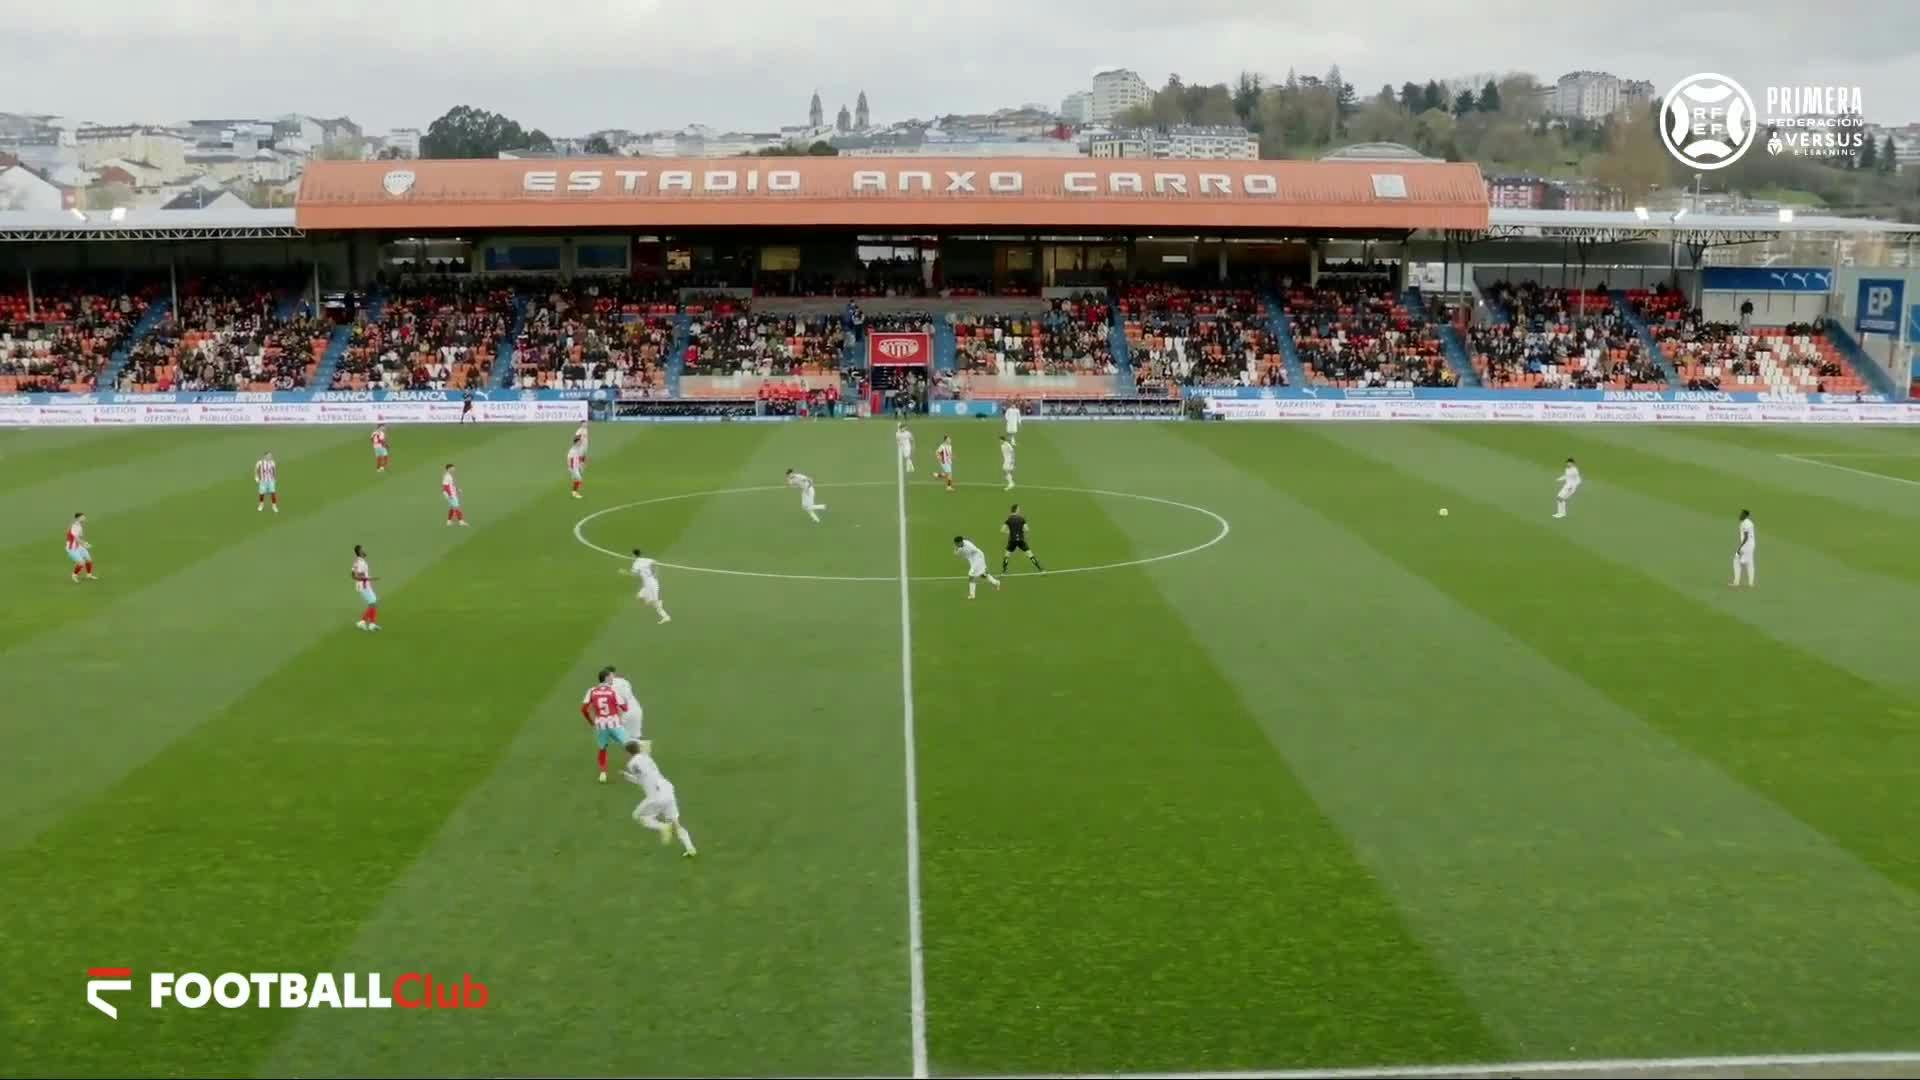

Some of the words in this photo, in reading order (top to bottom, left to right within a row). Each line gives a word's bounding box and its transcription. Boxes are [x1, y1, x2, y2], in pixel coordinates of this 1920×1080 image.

[523, 170, 801, 192] ESTADIO
[852, 171, 1023, 193] ANXO
[1064, 172, 1278, 195] CARRO
[312, 391, 375, 401] ABANCA
[384, 391, 448, 401] ABANCA
[1603, 391, 1664, 401] ABANCA
[1674, 391, 1735, 401] ABANCA
[597, 697, 609, 716] 5
